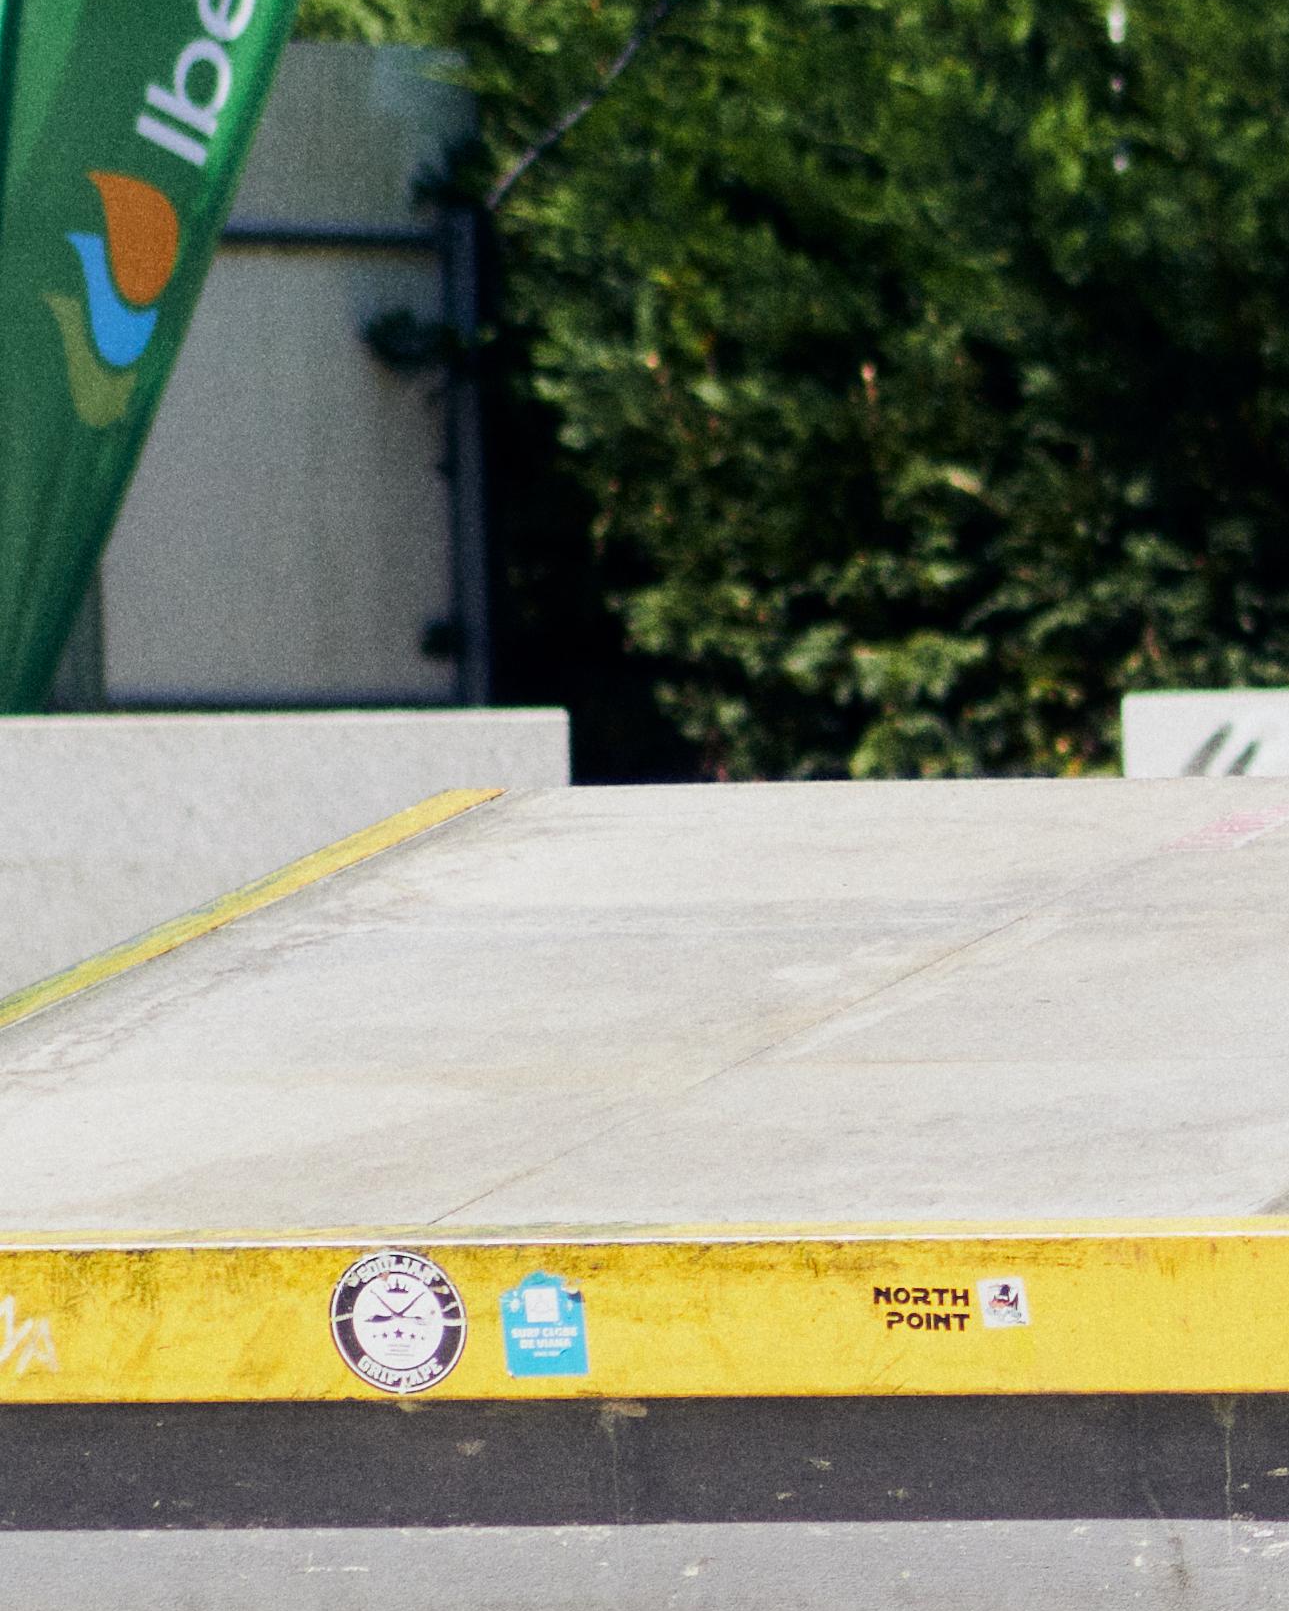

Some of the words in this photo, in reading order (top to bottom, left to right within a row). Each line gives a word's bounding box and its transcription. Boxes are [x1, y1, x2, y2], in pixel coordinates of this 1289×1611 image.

[872, 1285, 970, 1307] NORTH
[886, 1311, 970, 1332] POINT
[357, 1355, 444, 1388] GRIPTAPE
